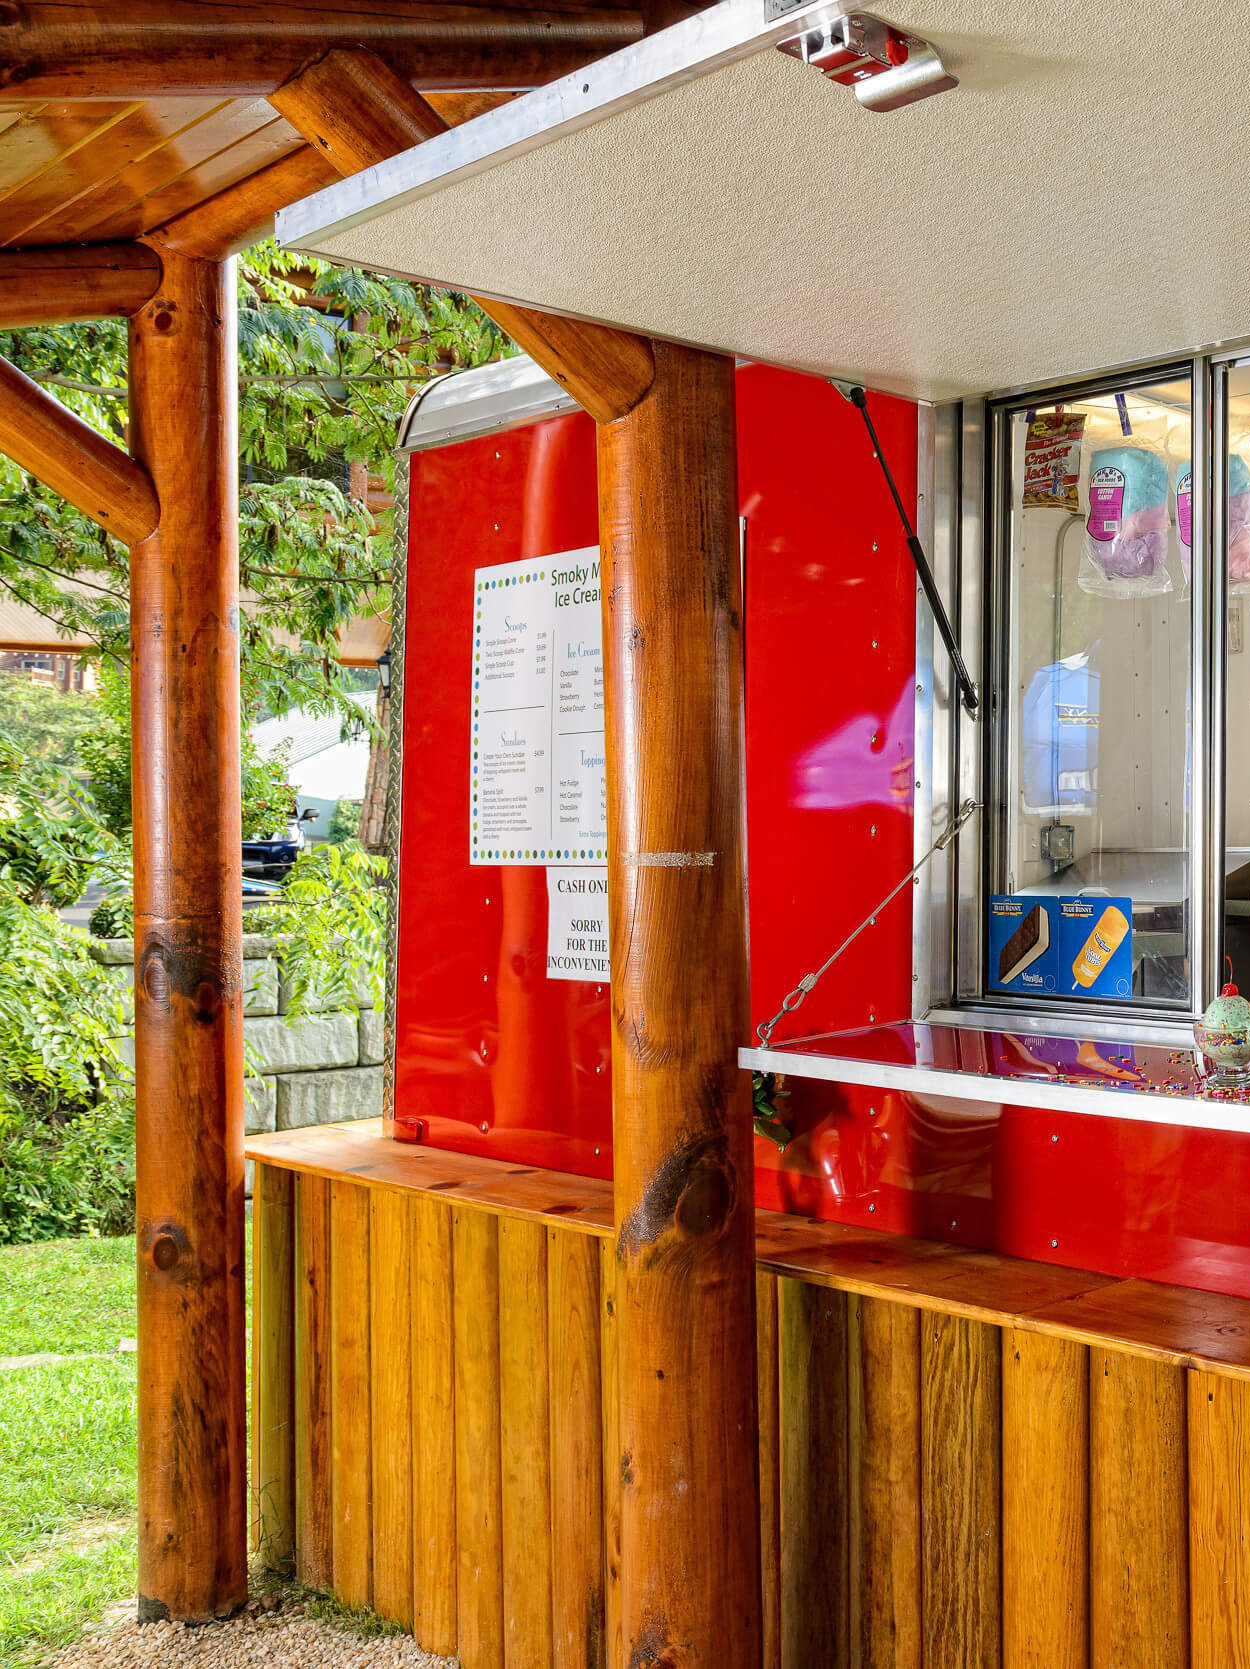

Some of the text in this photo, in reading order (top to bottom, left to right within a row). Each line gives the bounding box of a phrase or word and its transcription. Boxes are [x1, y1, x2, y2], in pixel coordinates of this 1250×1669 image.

[1025, 445, 1073, 467] Cracker
[1024, 462, 1052, 482] Jack
[551, 564, 589, 586] Smoky
[555, 587, 601, 608] Ice Crea
[504, 616, 528, 633] Scoops
[567, 640, 601, 659] Ice Cream
[557, 879, 586, 893] CASH
[571, 919, 603, 933] SORRY
[567, 938, 608, 952] FOR THE
[1021, 972, 1043, 983] Vanilla
